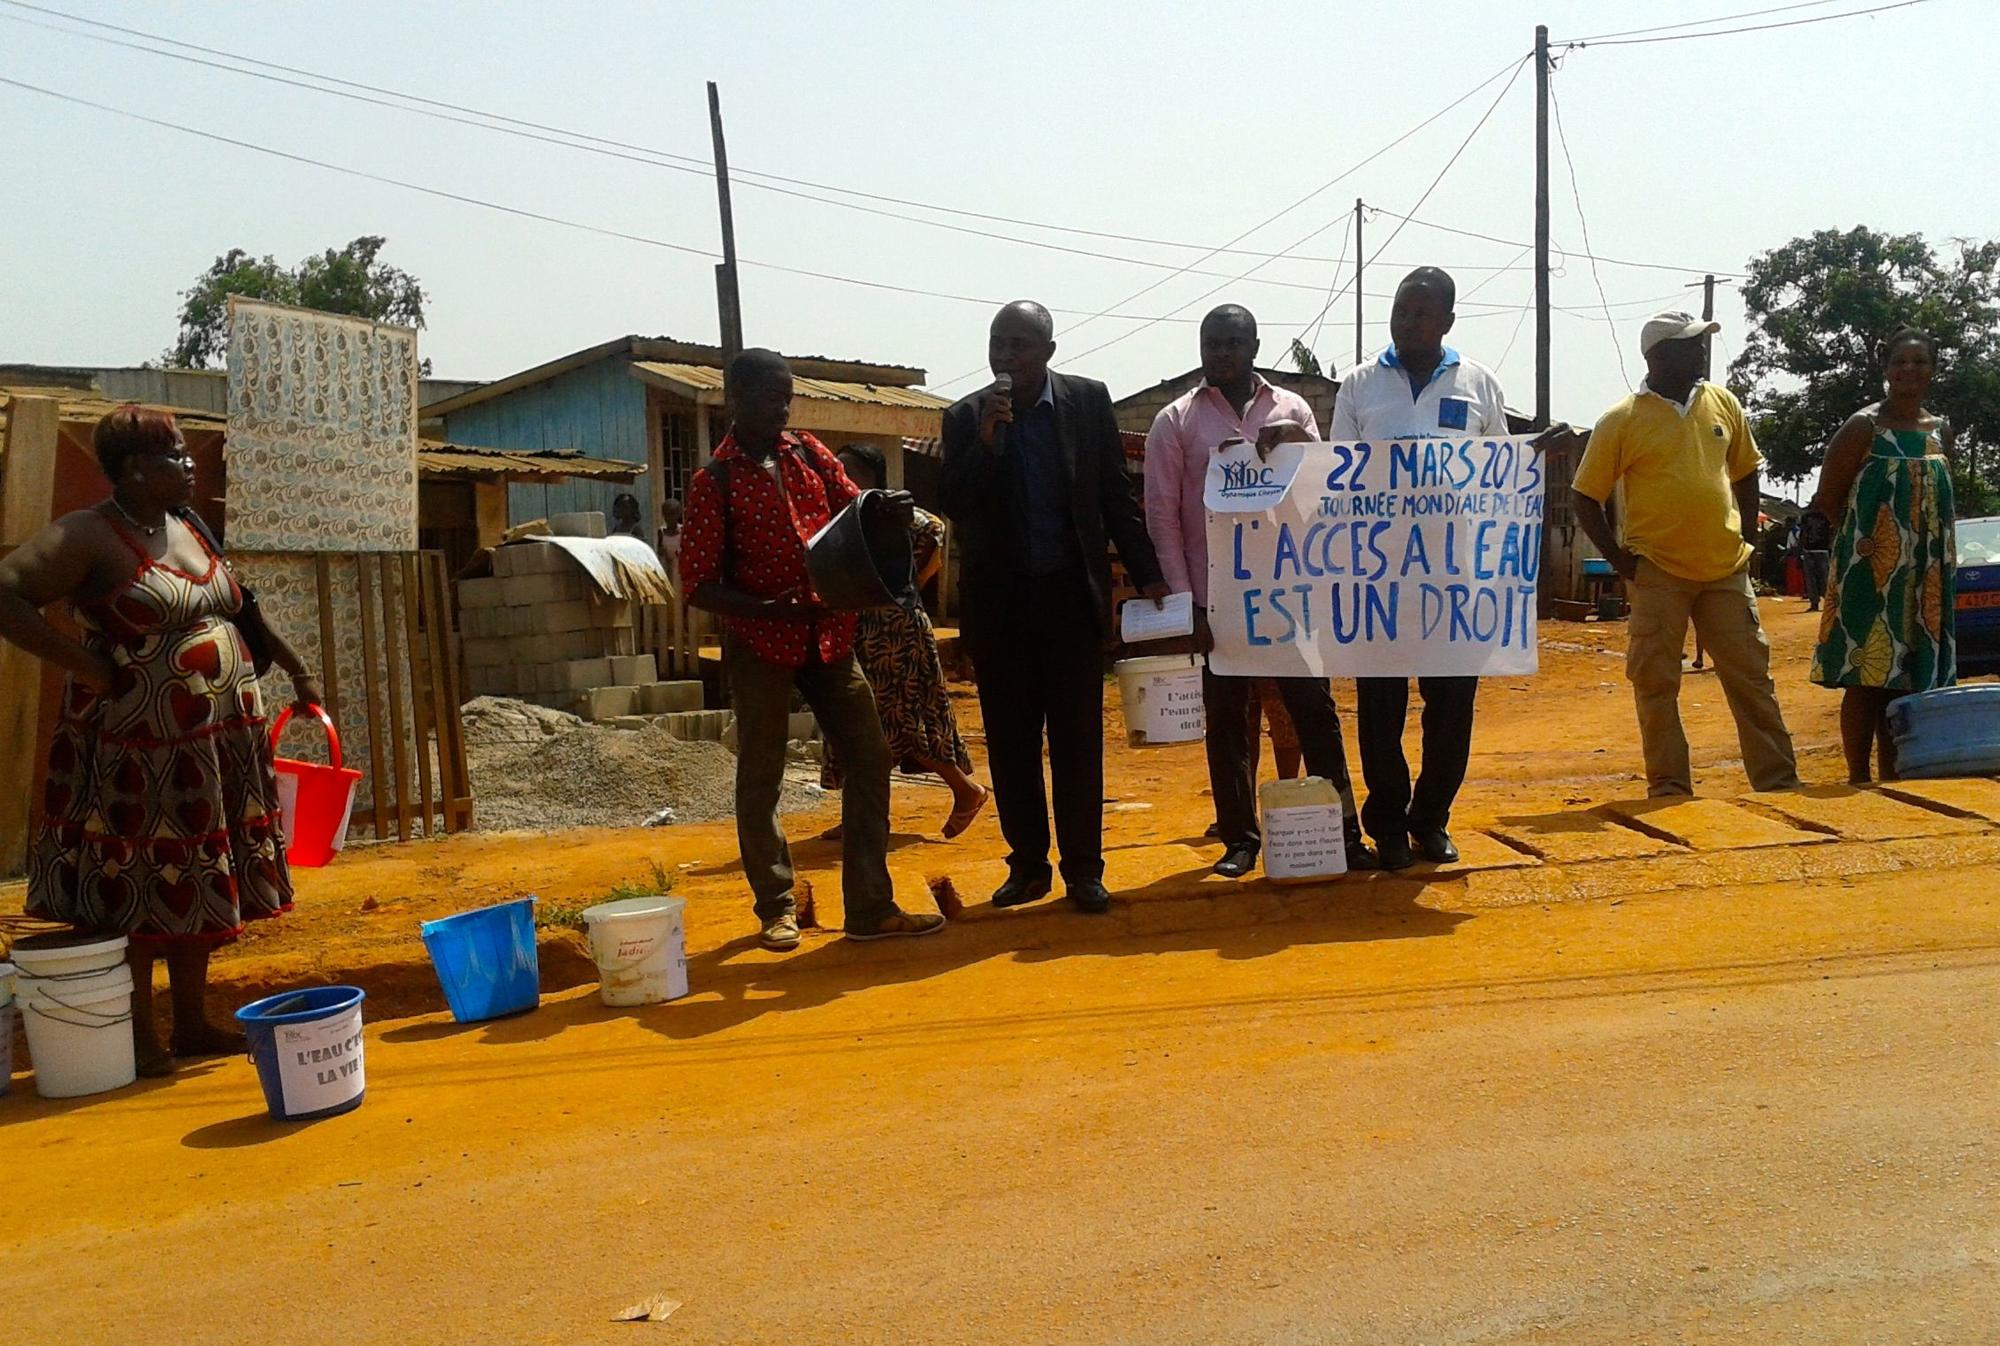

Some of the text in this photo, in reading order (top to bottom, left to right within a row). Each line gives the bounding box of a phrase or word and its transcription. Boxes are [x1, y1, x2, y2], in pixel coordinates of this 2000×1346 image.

[1327, 439, 1542, 494] 22 MARS 2013
[1318, 491, 1398, 518] JOURNÉE
[1402, 491, 1488, 518] MONDIALE
[1233, 518, 1542, 583] L'ACCES A L'EAU
[1242, 583, 1314, 647] EST
[1330, 580, 1399, 644] UN
[1418, 582, 1536, 650] DROIT
[296, 1042, 343, 1066] L'EAU
[316, 1068, 338, 1086] LA
[339, 1057, 359, 1078] VIE
